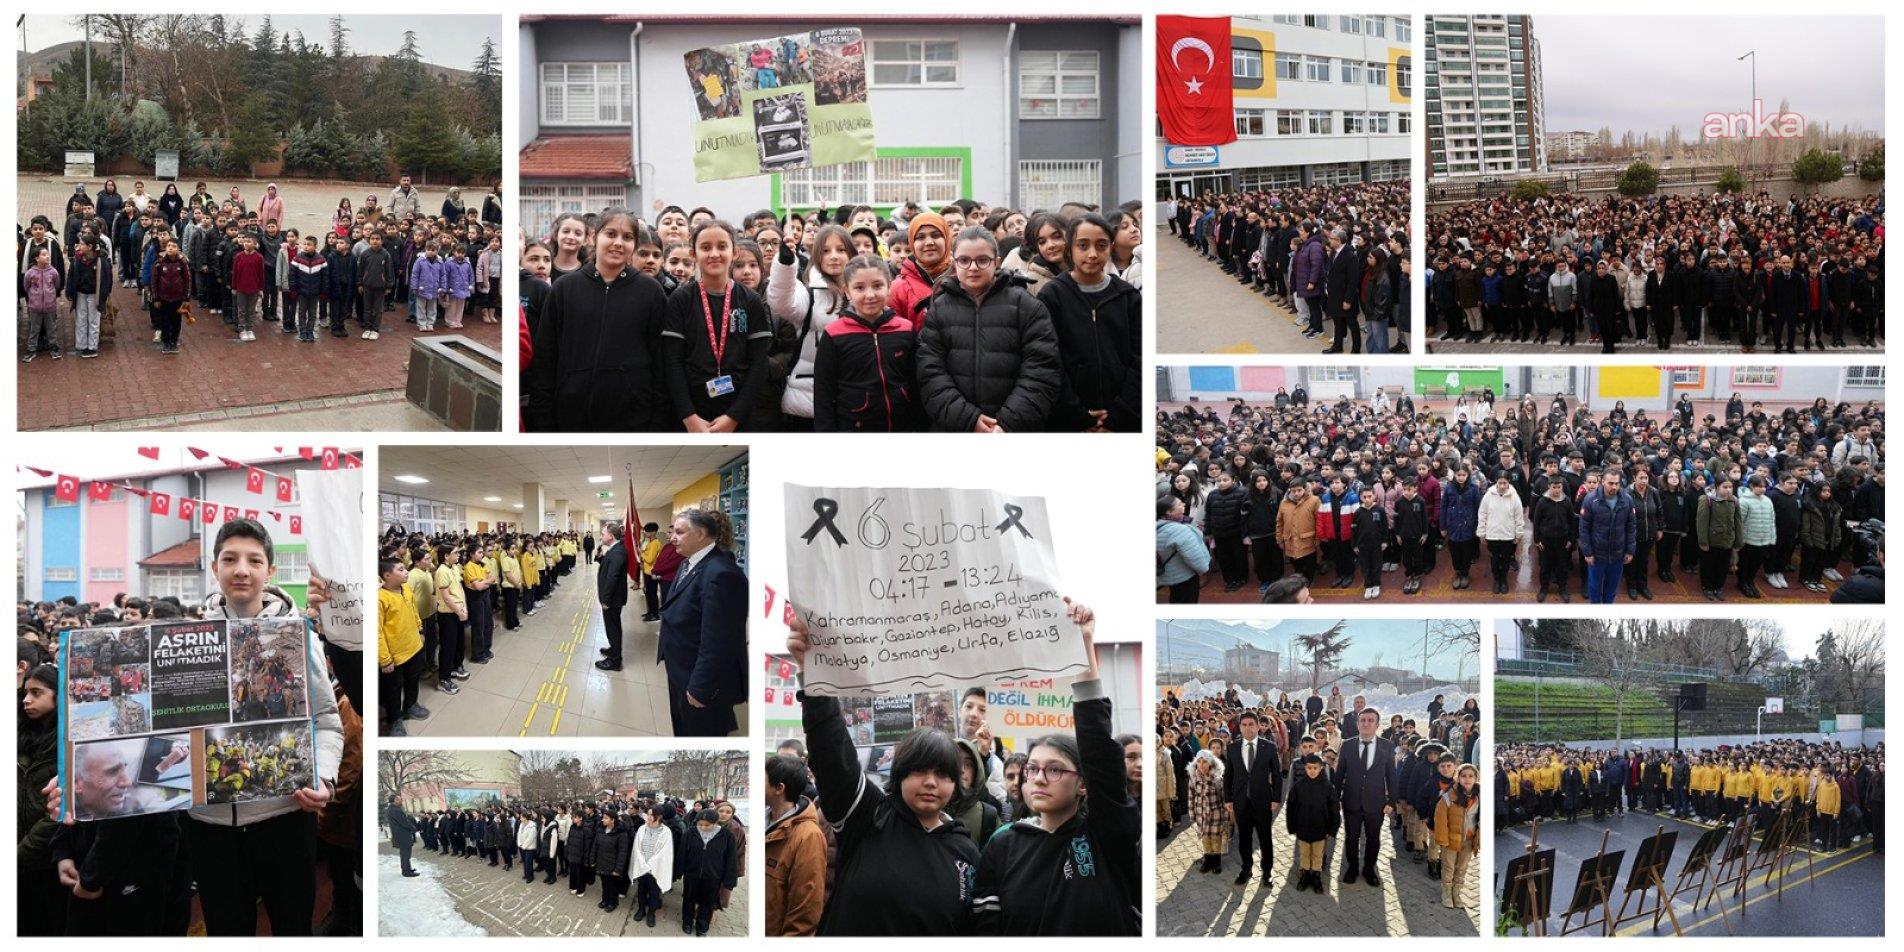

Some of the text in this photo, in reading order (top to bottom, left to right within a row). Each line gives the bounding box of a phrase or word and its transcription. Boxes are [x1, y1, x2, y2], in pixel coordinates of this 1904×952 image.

[857, 497, 991, 552] 6 Şubat
[898, 551, 951, 573] 2023
[869, 576, 931, 604] 04:17
[960, 563, 1024, 588] 13:24
[805, 610, 938, 628] Kahramanmaraş,
[885, 624, 960, 642] Gaziantep,
[963, 613, 1011, 628] Hatay,
[1017, 608, 1057, 620] Kilis,
[158, 631, 220, 649] ASRIN
[814, 625, 1060, 670] Malatya, Osmaniye, Urfa, Elazığ
[988, 689, 1075, 708] DEĞİL İHMA
